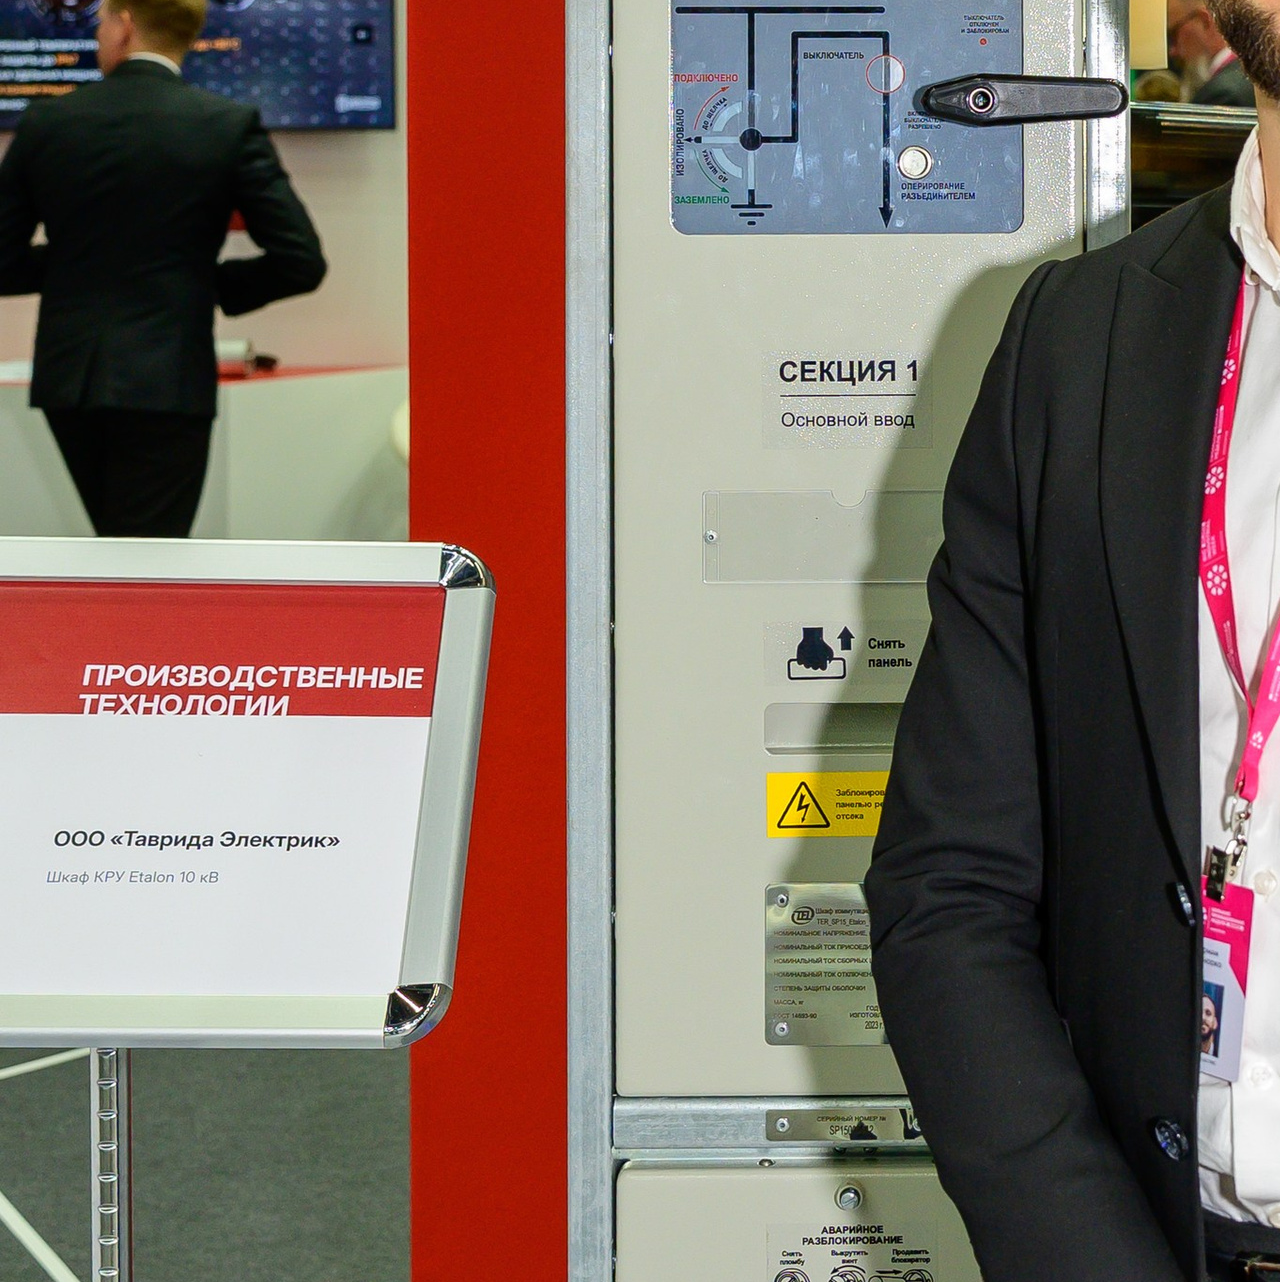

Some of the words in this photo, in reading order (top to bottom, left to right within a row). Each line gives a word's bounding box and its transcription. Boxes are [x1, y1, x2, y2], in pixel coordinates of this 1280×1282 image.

[803, 51, 865, 60] ВЫКЛЮЧАТЕЛЬ
[673, 73, 739, 84] ПОДКЛЮЧЕНО
[676, 108, 685, 176] ИЗОЛИРОВАНО
[901, 182, 965, 190] ОПЕРИРОВАНИЕ
[674, 195, 730, 204] ЗАЗЕМЛЕНО
[901, 192, 976, 201] РАЗЪЕДИНИТЕЛЕМ
[779, 360, 896, 386] СЕКЦИЯ
[907, 360, 918, 382] 1
[781, 412, 868, 428] Основной
[874, 414, 915, 429] ввод
[868, 637, 906, 649] Снять
[868, 658, 912, 668] панель
[82, 664, 425, 691] ПРОИЗВОДСТВЕННЫЕ
[78, 693, 290, 716] ТЕХНОЛОГИИ
[835, 789, 887, 798] Заблокиров
[54, 830, 105, 847] ООО
[110, 830, 214, 850] «Таврида
[219, 830, 341, 851] Электрик»
[46, 870, 90, 885] Шкаф
[94, 871, 125, 883] КРУ
[129, 871, 175, 883] Etalon
[180, 871, 196, 883] 10
[200, 871, 219, 883] кВ
[821, 1224, 884, 1235] АВАРИЙНОЕ
[802, 1235, 904, 1246] РАЗБЛОКИРОВАНИЕ
